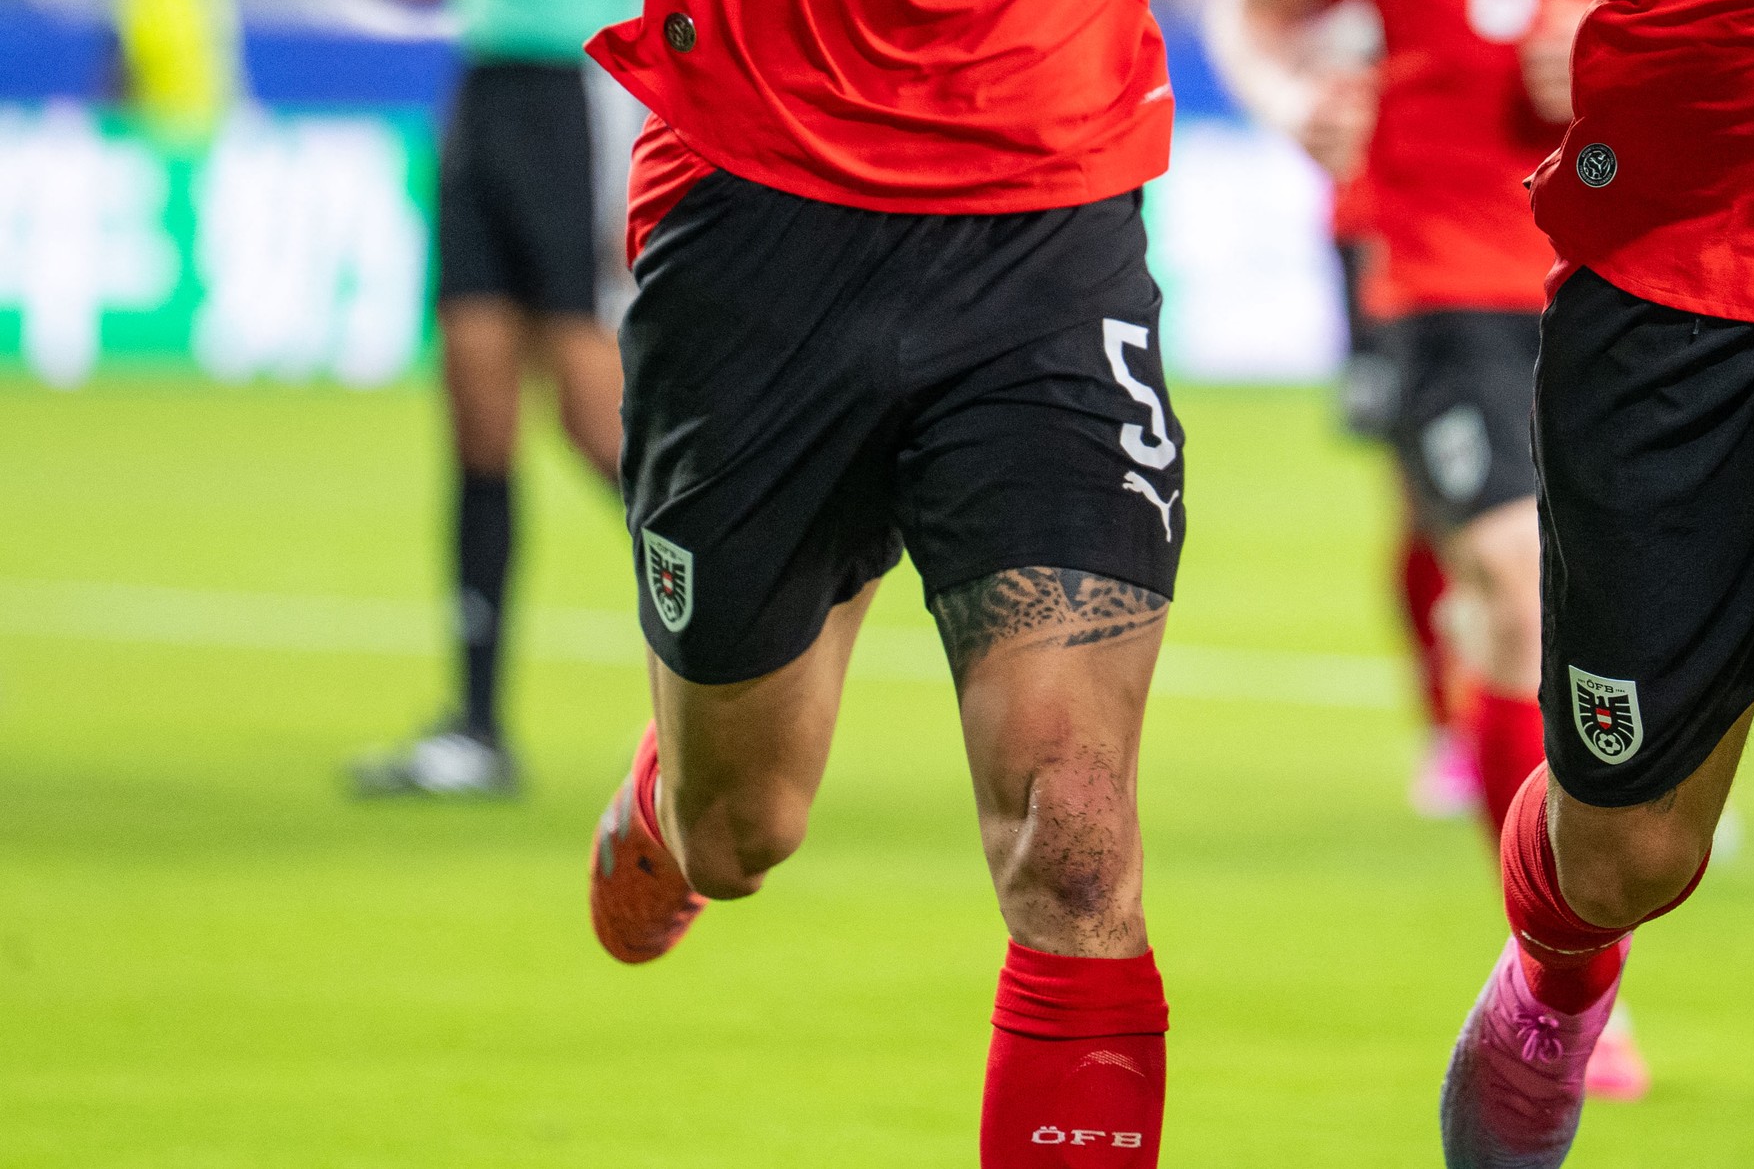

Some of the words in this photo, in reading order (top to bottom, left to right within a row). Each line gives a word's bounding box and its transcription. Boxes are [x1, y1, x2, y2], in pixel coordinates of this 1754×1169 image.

[1102, 317, 1176, 471] 5
[1587, 679, 1614, 694] ÖFB
[1031, 1125, 1142, 1149] ÖFB
